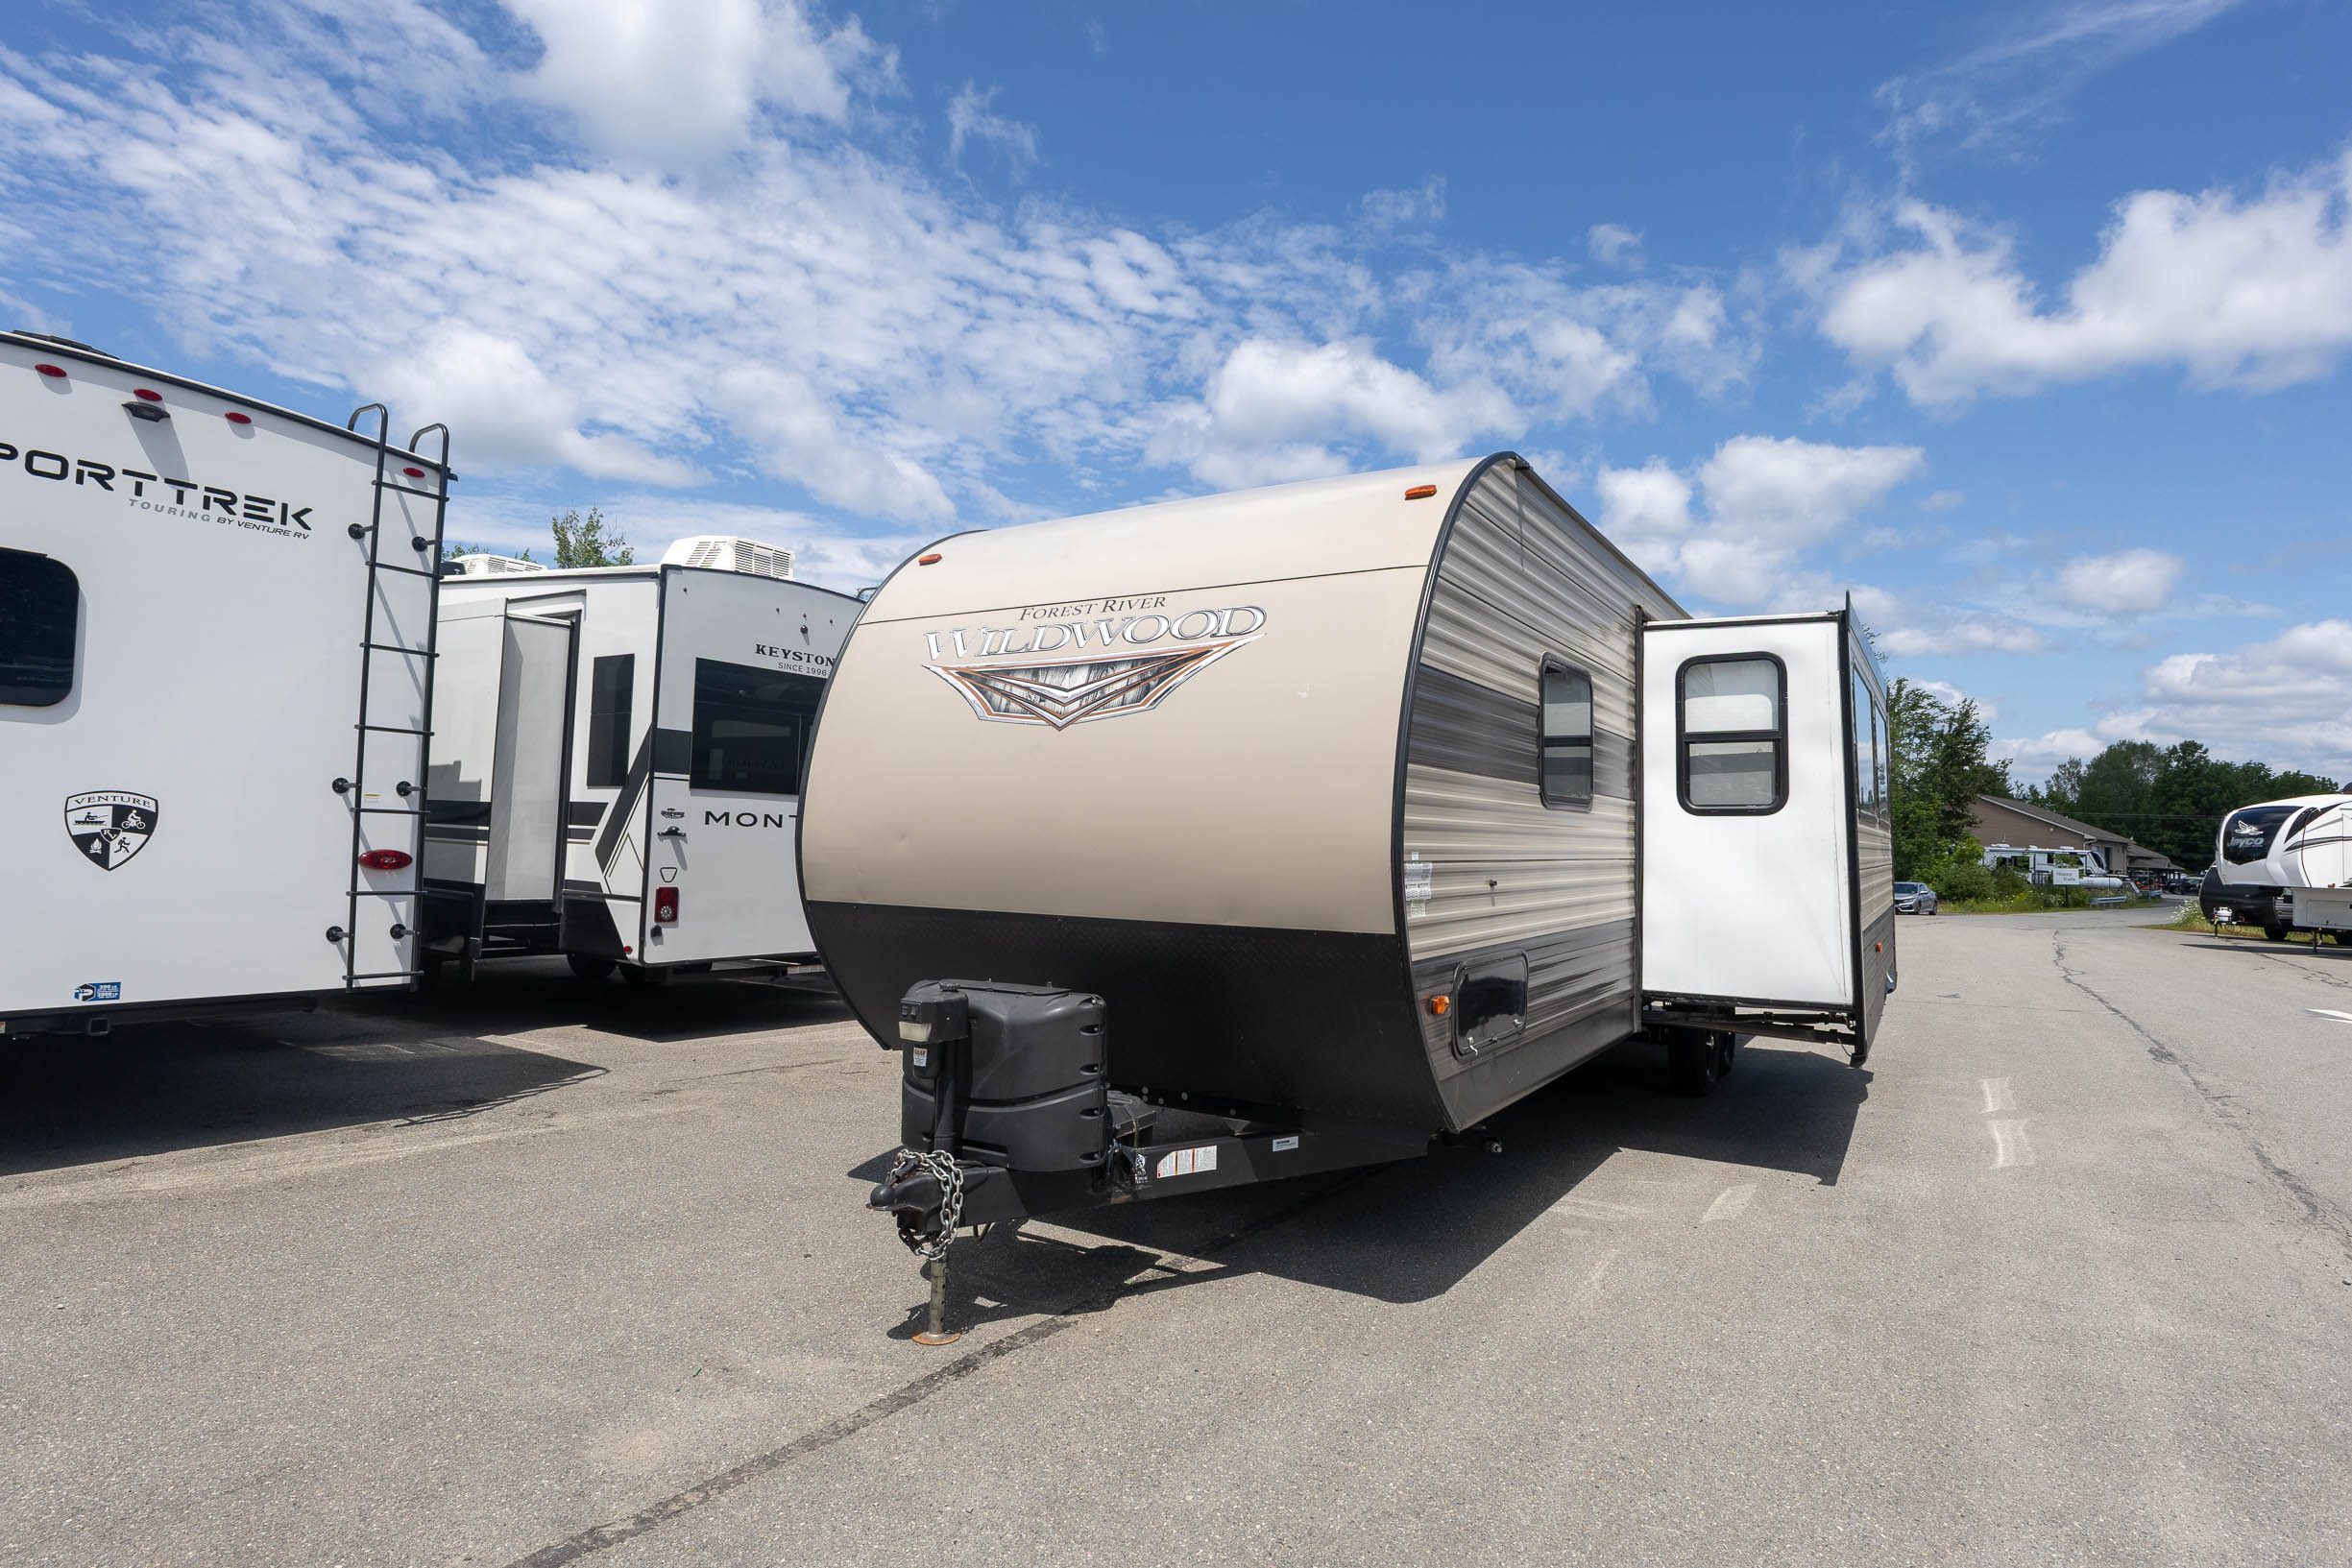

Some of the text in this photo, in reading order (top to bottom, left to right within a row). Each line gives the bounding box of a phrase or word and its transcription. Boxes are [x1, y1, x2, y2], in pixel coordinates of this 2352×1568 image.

[128, 498, 211, 522] TOURING
[217, 517, 310, 540] BY VENTURE RV
[1019, 596, 1166, 620] FOREST RIVER
[921, 606, 1268, 661] WILDWOOD
[778, 662, 827, 677] SINCE 1996
[74, 795, 152, 808] VENTURE
[704, 810, 797, 829] MON
